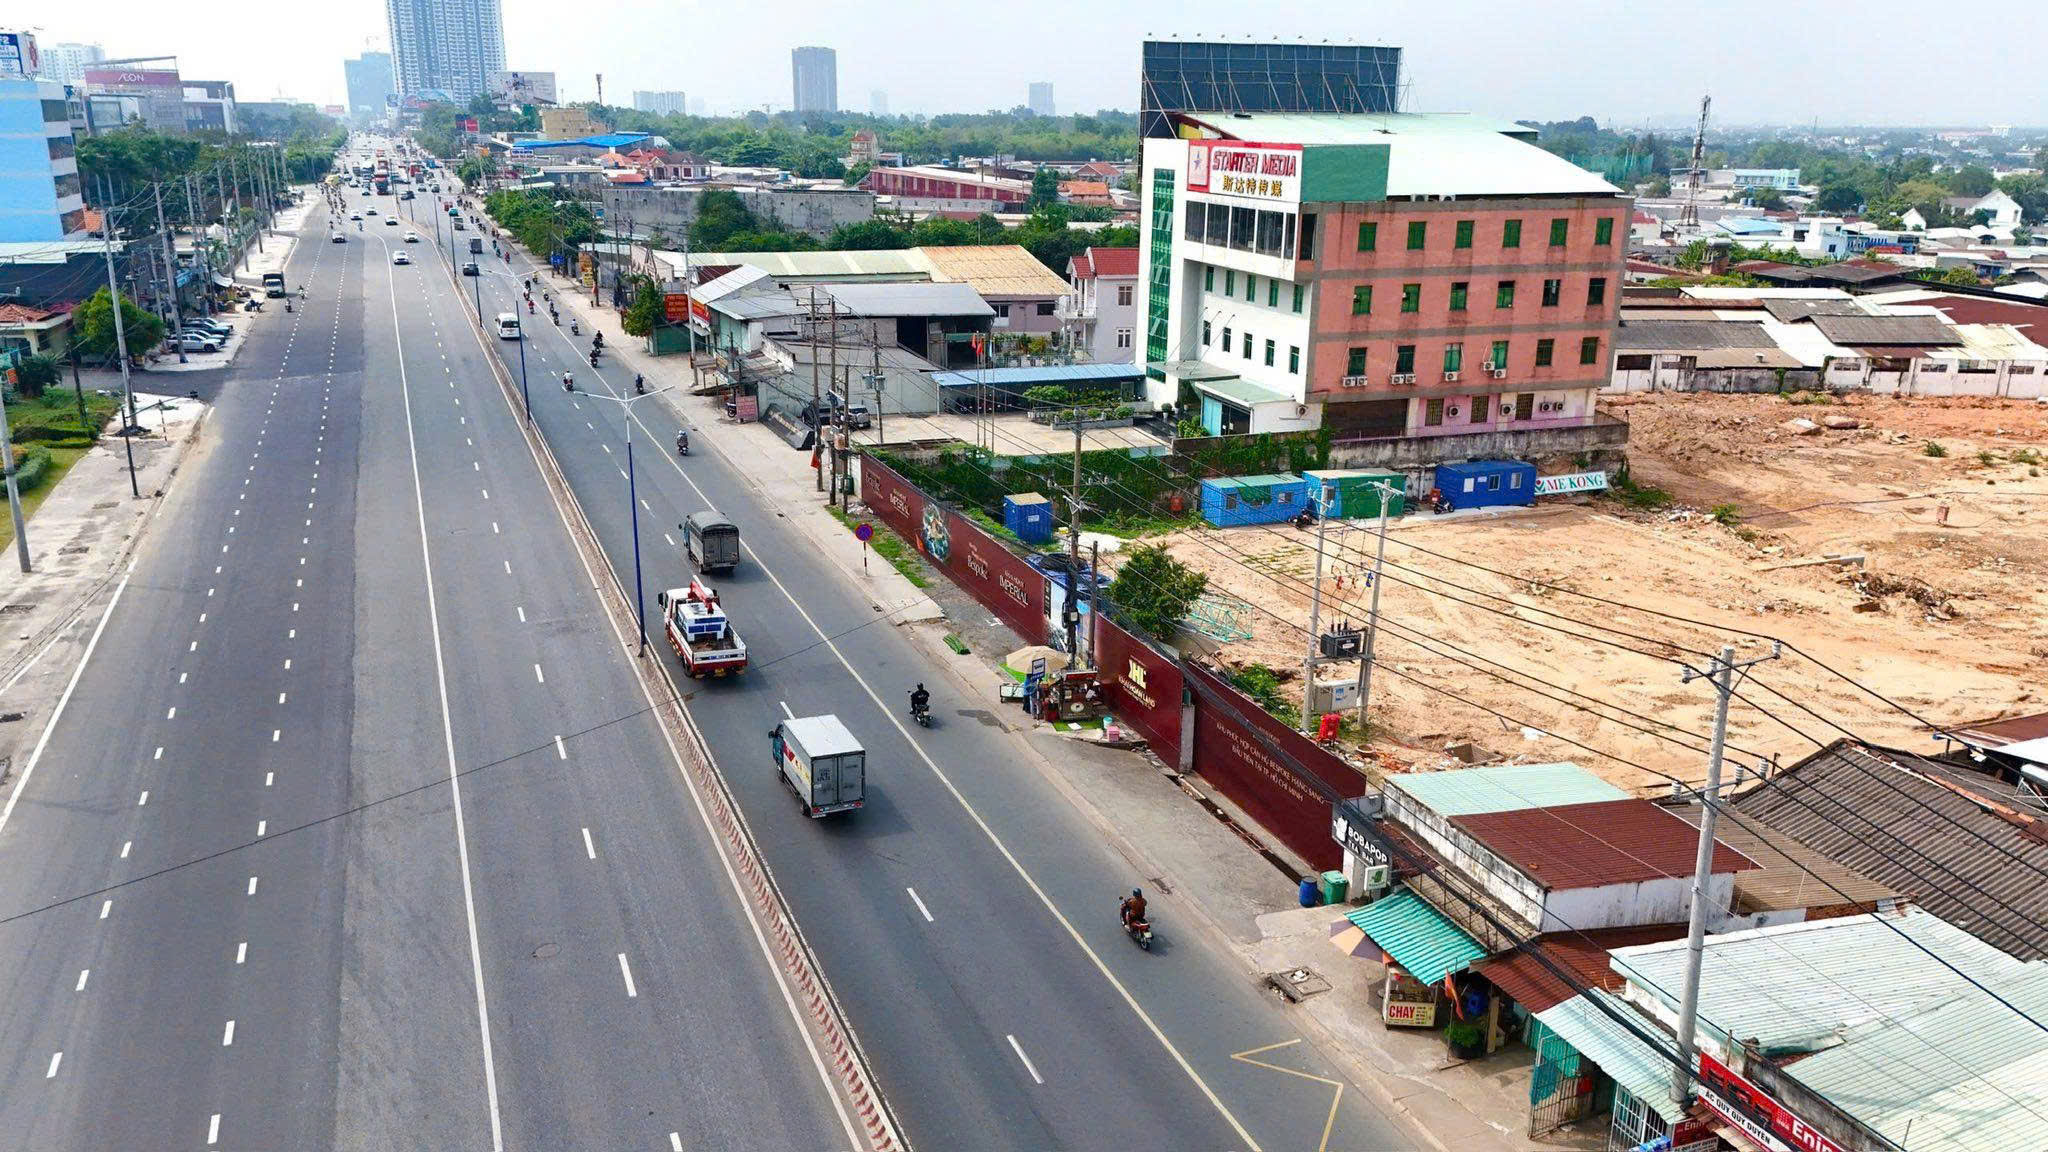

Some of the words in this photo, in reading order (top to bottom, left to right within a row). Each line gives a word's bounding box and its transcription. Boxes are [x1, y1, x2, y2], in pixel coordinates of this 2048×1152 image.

[1212, 150, 1258, 174] STARTER
[1261, 154, 1296, 177] MEDIA
[1348, 826, 1387, 863] BOBAPOP
[1348, 840, 1359, 853] TEA
[1362, 851, 1374, 866] BAR
[1389, 1005, 1415, 1019] CHAY
